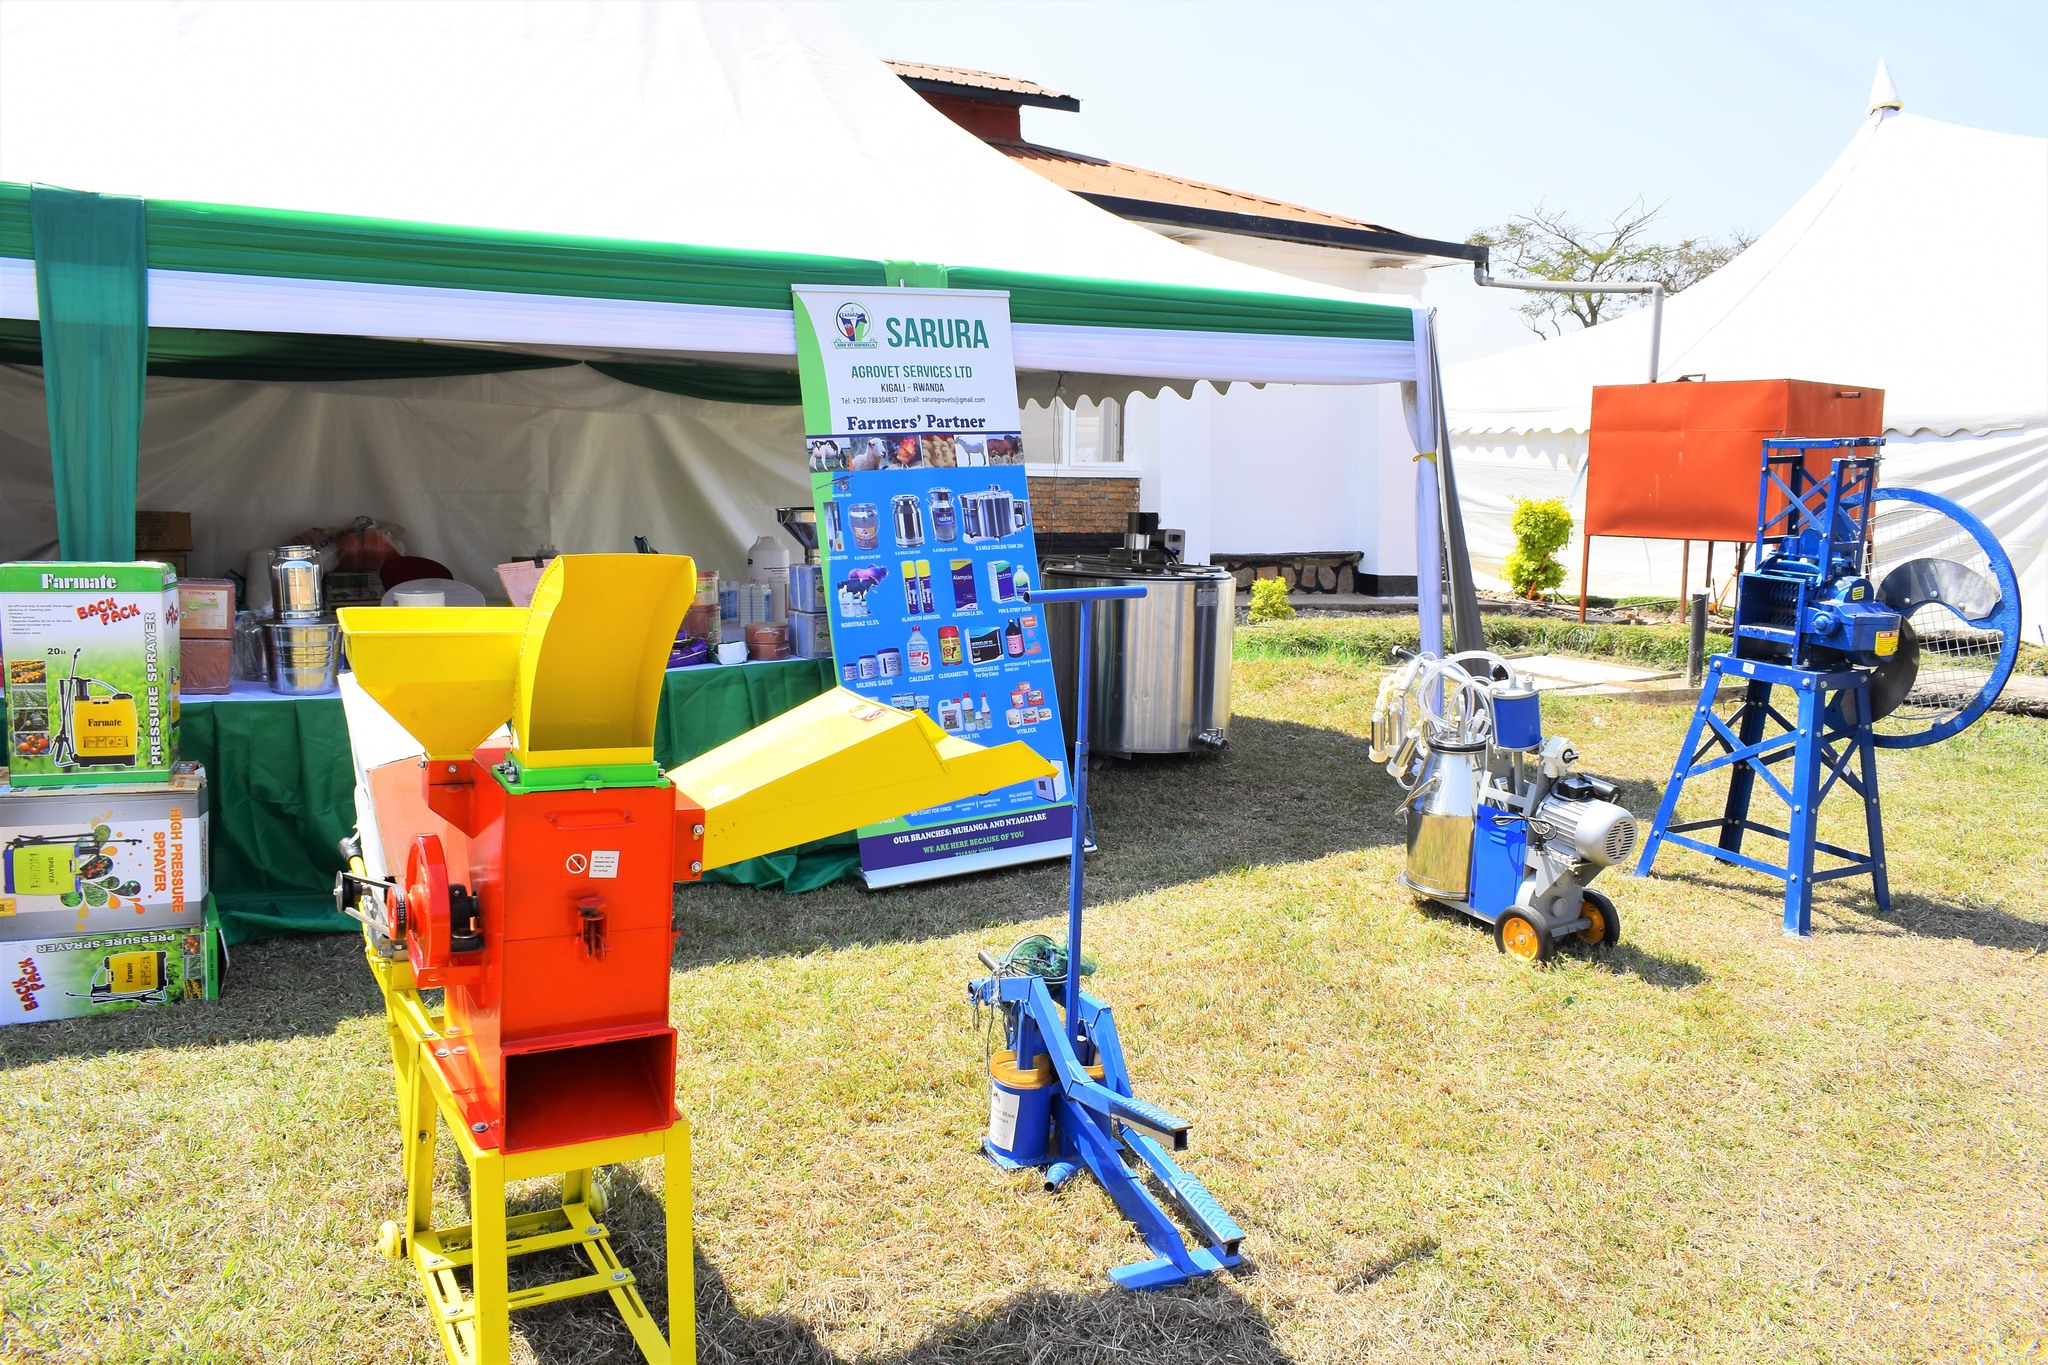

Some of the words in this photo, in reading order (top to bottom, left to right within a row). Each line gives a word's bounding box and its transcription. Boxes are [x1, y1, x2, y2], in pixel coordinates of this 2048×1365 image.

[886, 317, 989, 349] SARURA
[851, 365, 900, 378] AGROVET
[902, 365, 952, 378] SERVICES
[954, 366, 973, 378] LTD
[880, 383, 906, 392] KIGALI
[913, 383, 945, 392] RWANDA
[903, 395, 920, 403] Email:
[926, 414, 986, 428] Partner
[40, 573, 118, 590] Farmate
[953, 574, 973, 582] Alamycin
[76, 597, 118, 620] BACK
[100, 603, 141, 626] PACK
[144, 612, 158, 682] SPRAYER
[921, 651, 929, 666] 5
[88, 718, 122, 728] Farmate
[147, 686, 162, 765] PRESSURE
[169, 807, 183, 840] HIGH
[893, 837, 910, 845] OUR
[910, 830, 952, 842] BRANCHES:
[952, 823, 989, 835] MUHANGA
[989, 819, 1005, 828] AND
[1005, 813, 1047, 826] NYAGATARE
[923, 846, 935, 854] WE
[936, 843, 950, 852] ARE
[950, 841, 969, 850] HERE
[969, 835, 1000, 846] BECAUSE
[153, 831, 167, 893] SPRAYER
[170, 842, 184, 913] PRESSURE
[36, 940, 101, 953] SPRAYER
[105, 933, 176, 946] PRESSURE
[17, 956, 45, 993] PACK
[12, 973, 39, 1012] BACK
